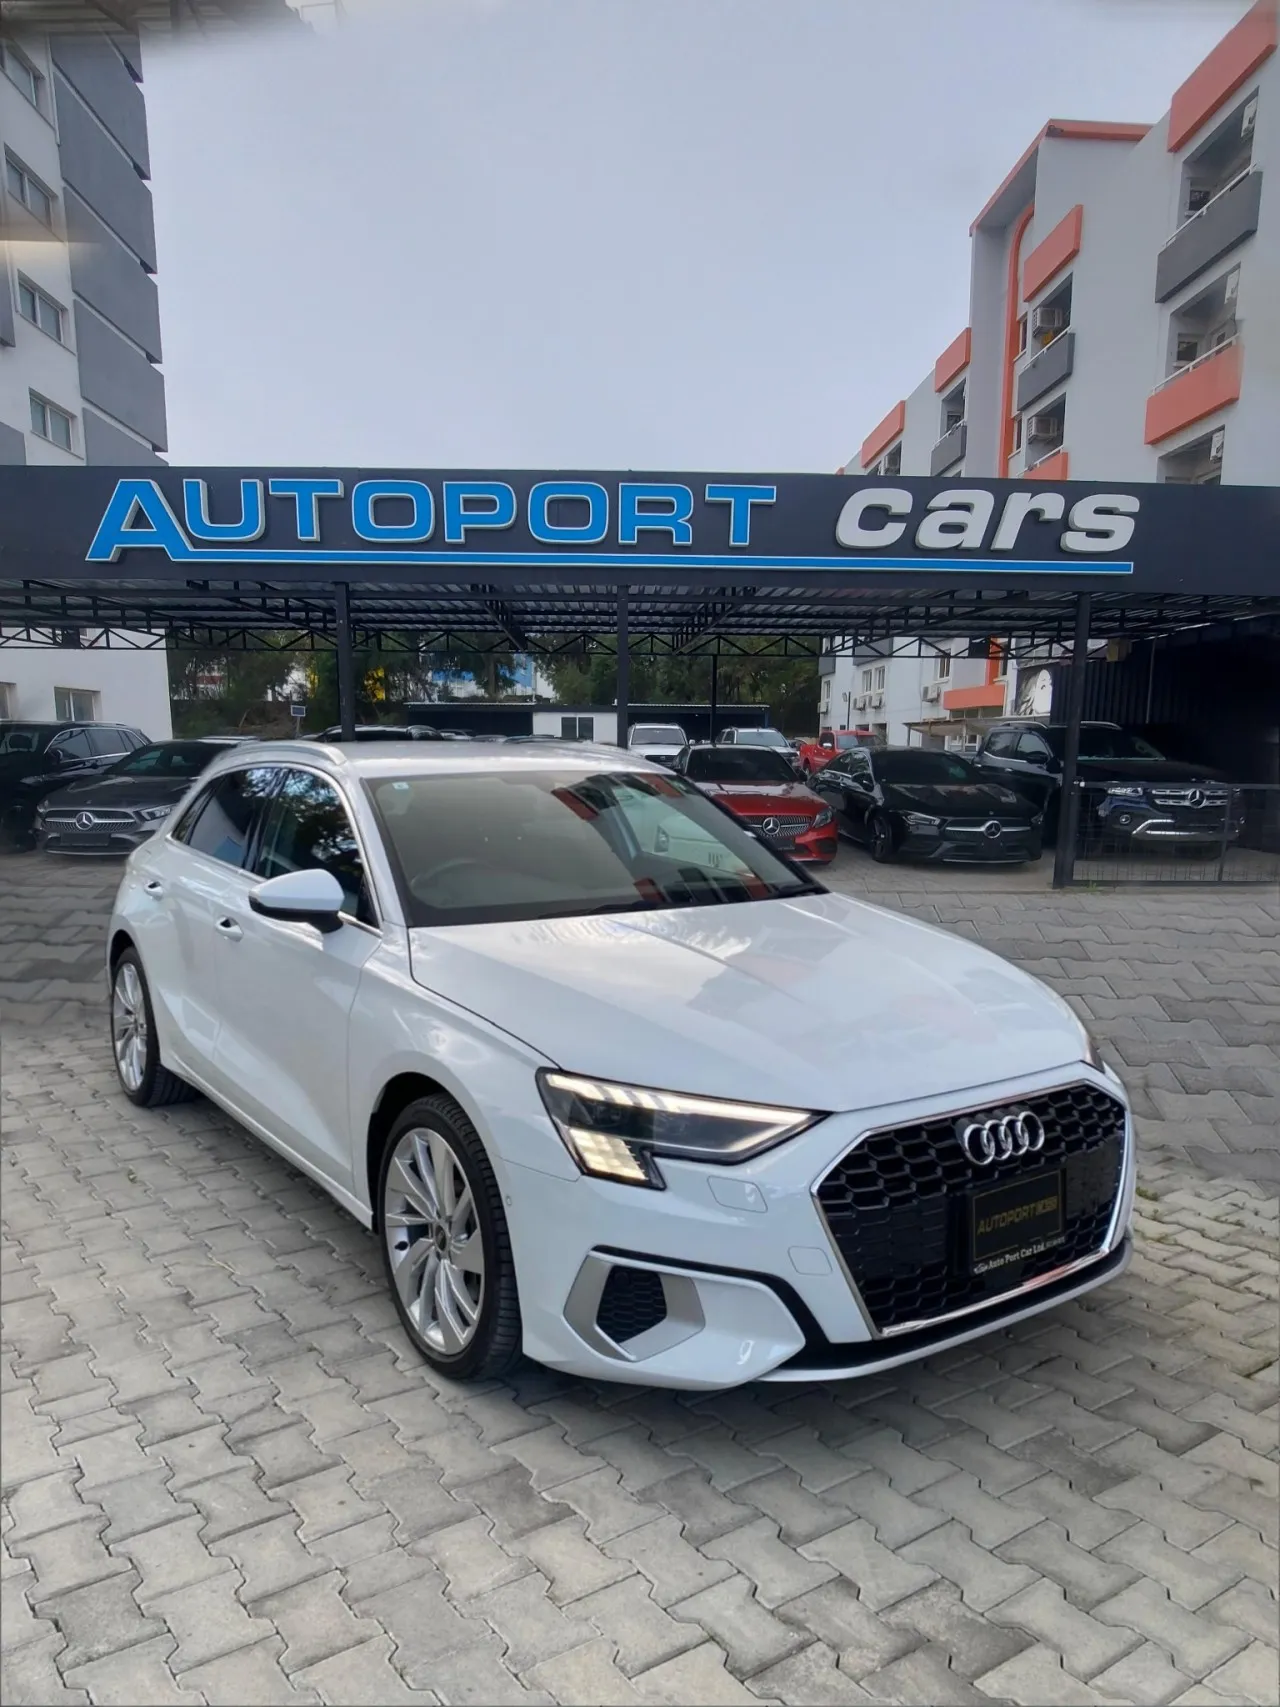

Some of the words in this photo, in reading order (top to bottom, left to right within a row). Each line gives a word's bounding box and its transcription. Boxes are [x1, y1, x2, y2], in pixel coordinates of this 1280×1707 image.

[85, 478, 777, 563] AUTOPORT
[835, 487, 1141, 554] cars
[988, 1257, 1004, 1270] Auto
[1004, 1251, 1020, 1263] Port
